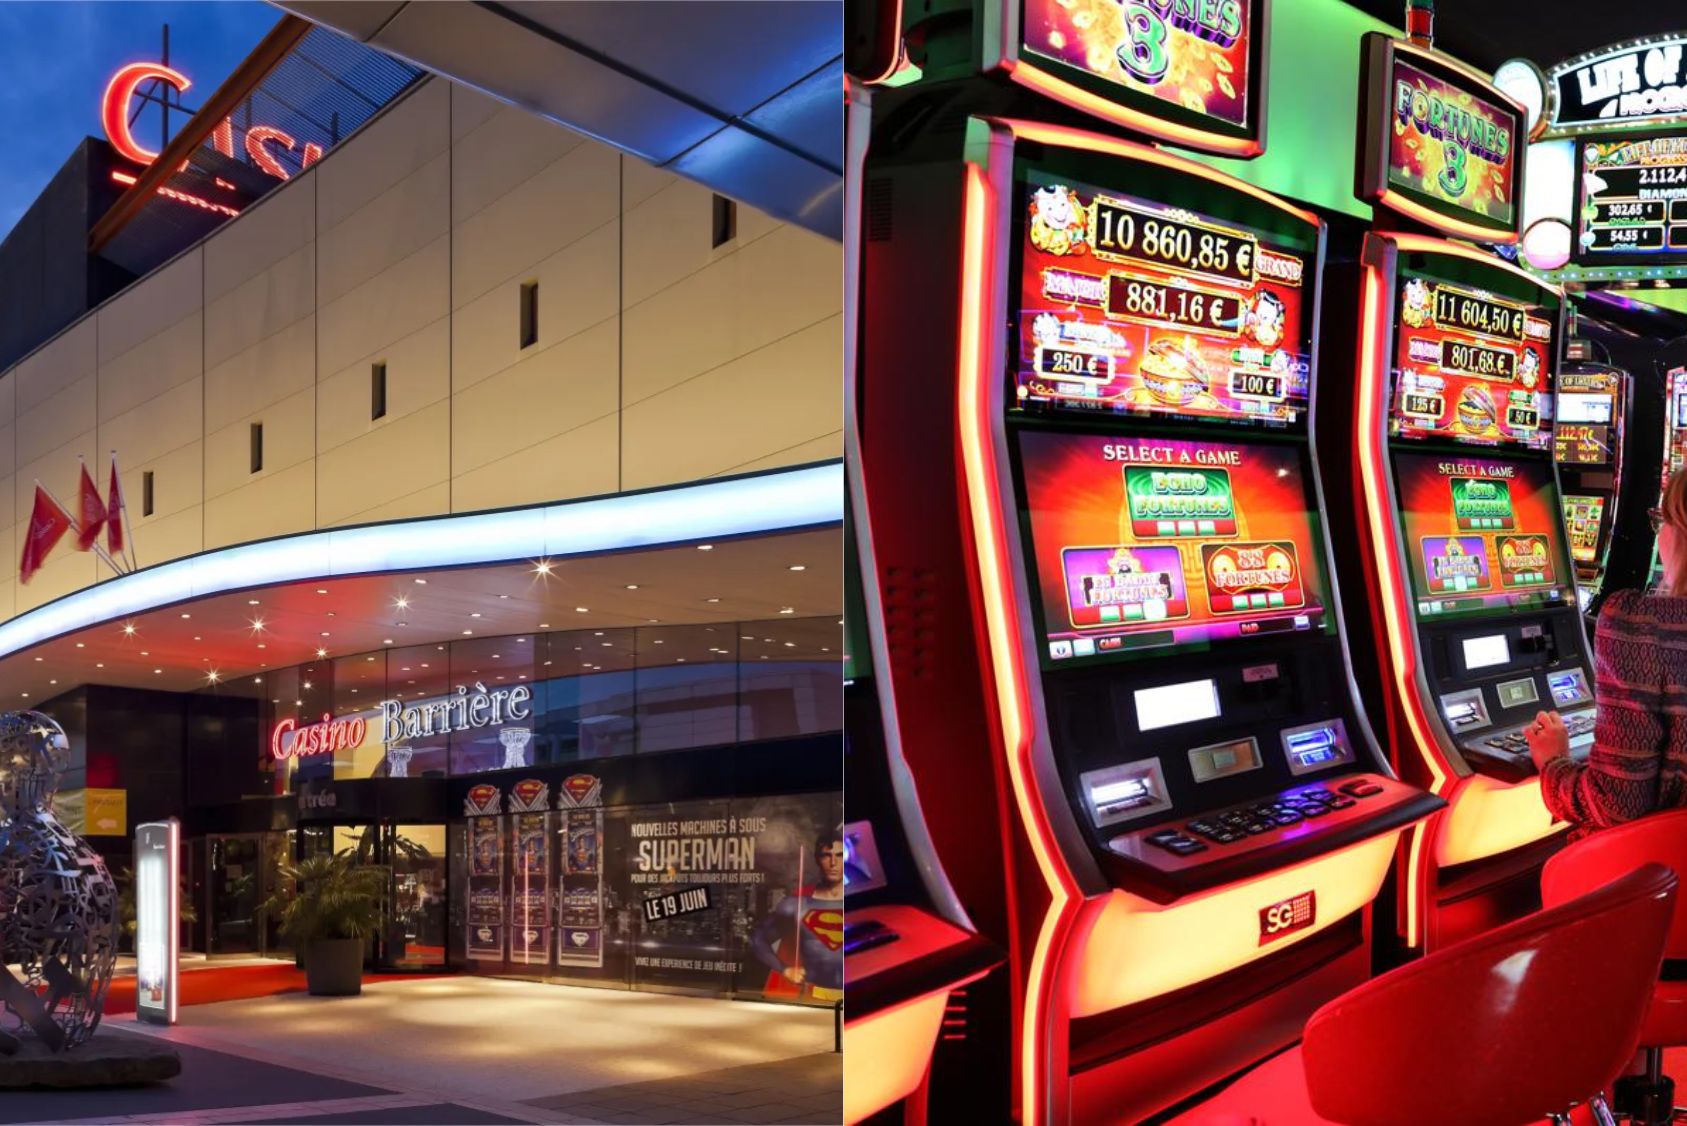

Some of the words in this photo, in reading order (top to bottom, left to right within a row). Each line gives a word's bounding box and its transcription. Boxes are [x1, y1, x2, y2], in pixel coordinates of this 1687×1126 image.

[1116, 4, 1169, 85] 3
[1577, 53, 1641, 105] LIFE
[1644, 45, 1683, 87] OF
[1396, 80, 1509, 164] FORTUNES
[1438, 139, 1467, 198] 3
[1100, 211, 1135, 250] 10
[1142, 221, 1230, 271] 860,85
[1236, 244, 1251, 276] €
[1255, 252, 1302, 280] GRAND
[1126, 283, 1205, 323] 881,16
[1210, 302, 1223, 325] €
[1439, 294, 1456, 322] 11
[1461, 300, 1510, 334] 604,50
[1513, 313, 1522, 337] €
[1052, 352, 1083, 375] 250
[1087, 358, 1099, 376] €
[1497, 355, 1506, 375] €
[1241, 376, 1263, 394] 100
[1266, 379, 1275, 395] €
[1103, 445, 1173, 463] SELECT
[1179, 450, 1192, 464] A
[1196, 449, 1241, 465] GAME
[1152, 471, 1208, 495] ECHO
[1438, 463, 1477, 476] SELECT
[1480, 466, 1487, 476] A
[1488, 466, 1515, 478] GAME
[1135, 495, 1232, 517] FORTUNES
[1238, 549, 1265, 569] 88
[1215, 569, 1291, 588] FORTUNES
[272, 713, 366, 760] Casino
[381, 682, 532, 744] Barrière
[631, 822, 678, 837] NOUVELLES
[680, 819, 727, 836] MACHINES
[739, 817, 766, 833] SOUS
[639, 837, 756, 871] SUPERMAN
[630, 873, 647, 884] POUR
[645, 900, 660, 920] LE
[662, 897, 677, 917] 19
[680, 888, 708, 912] JUIN
[1267, 902, 1295, 934] SG
